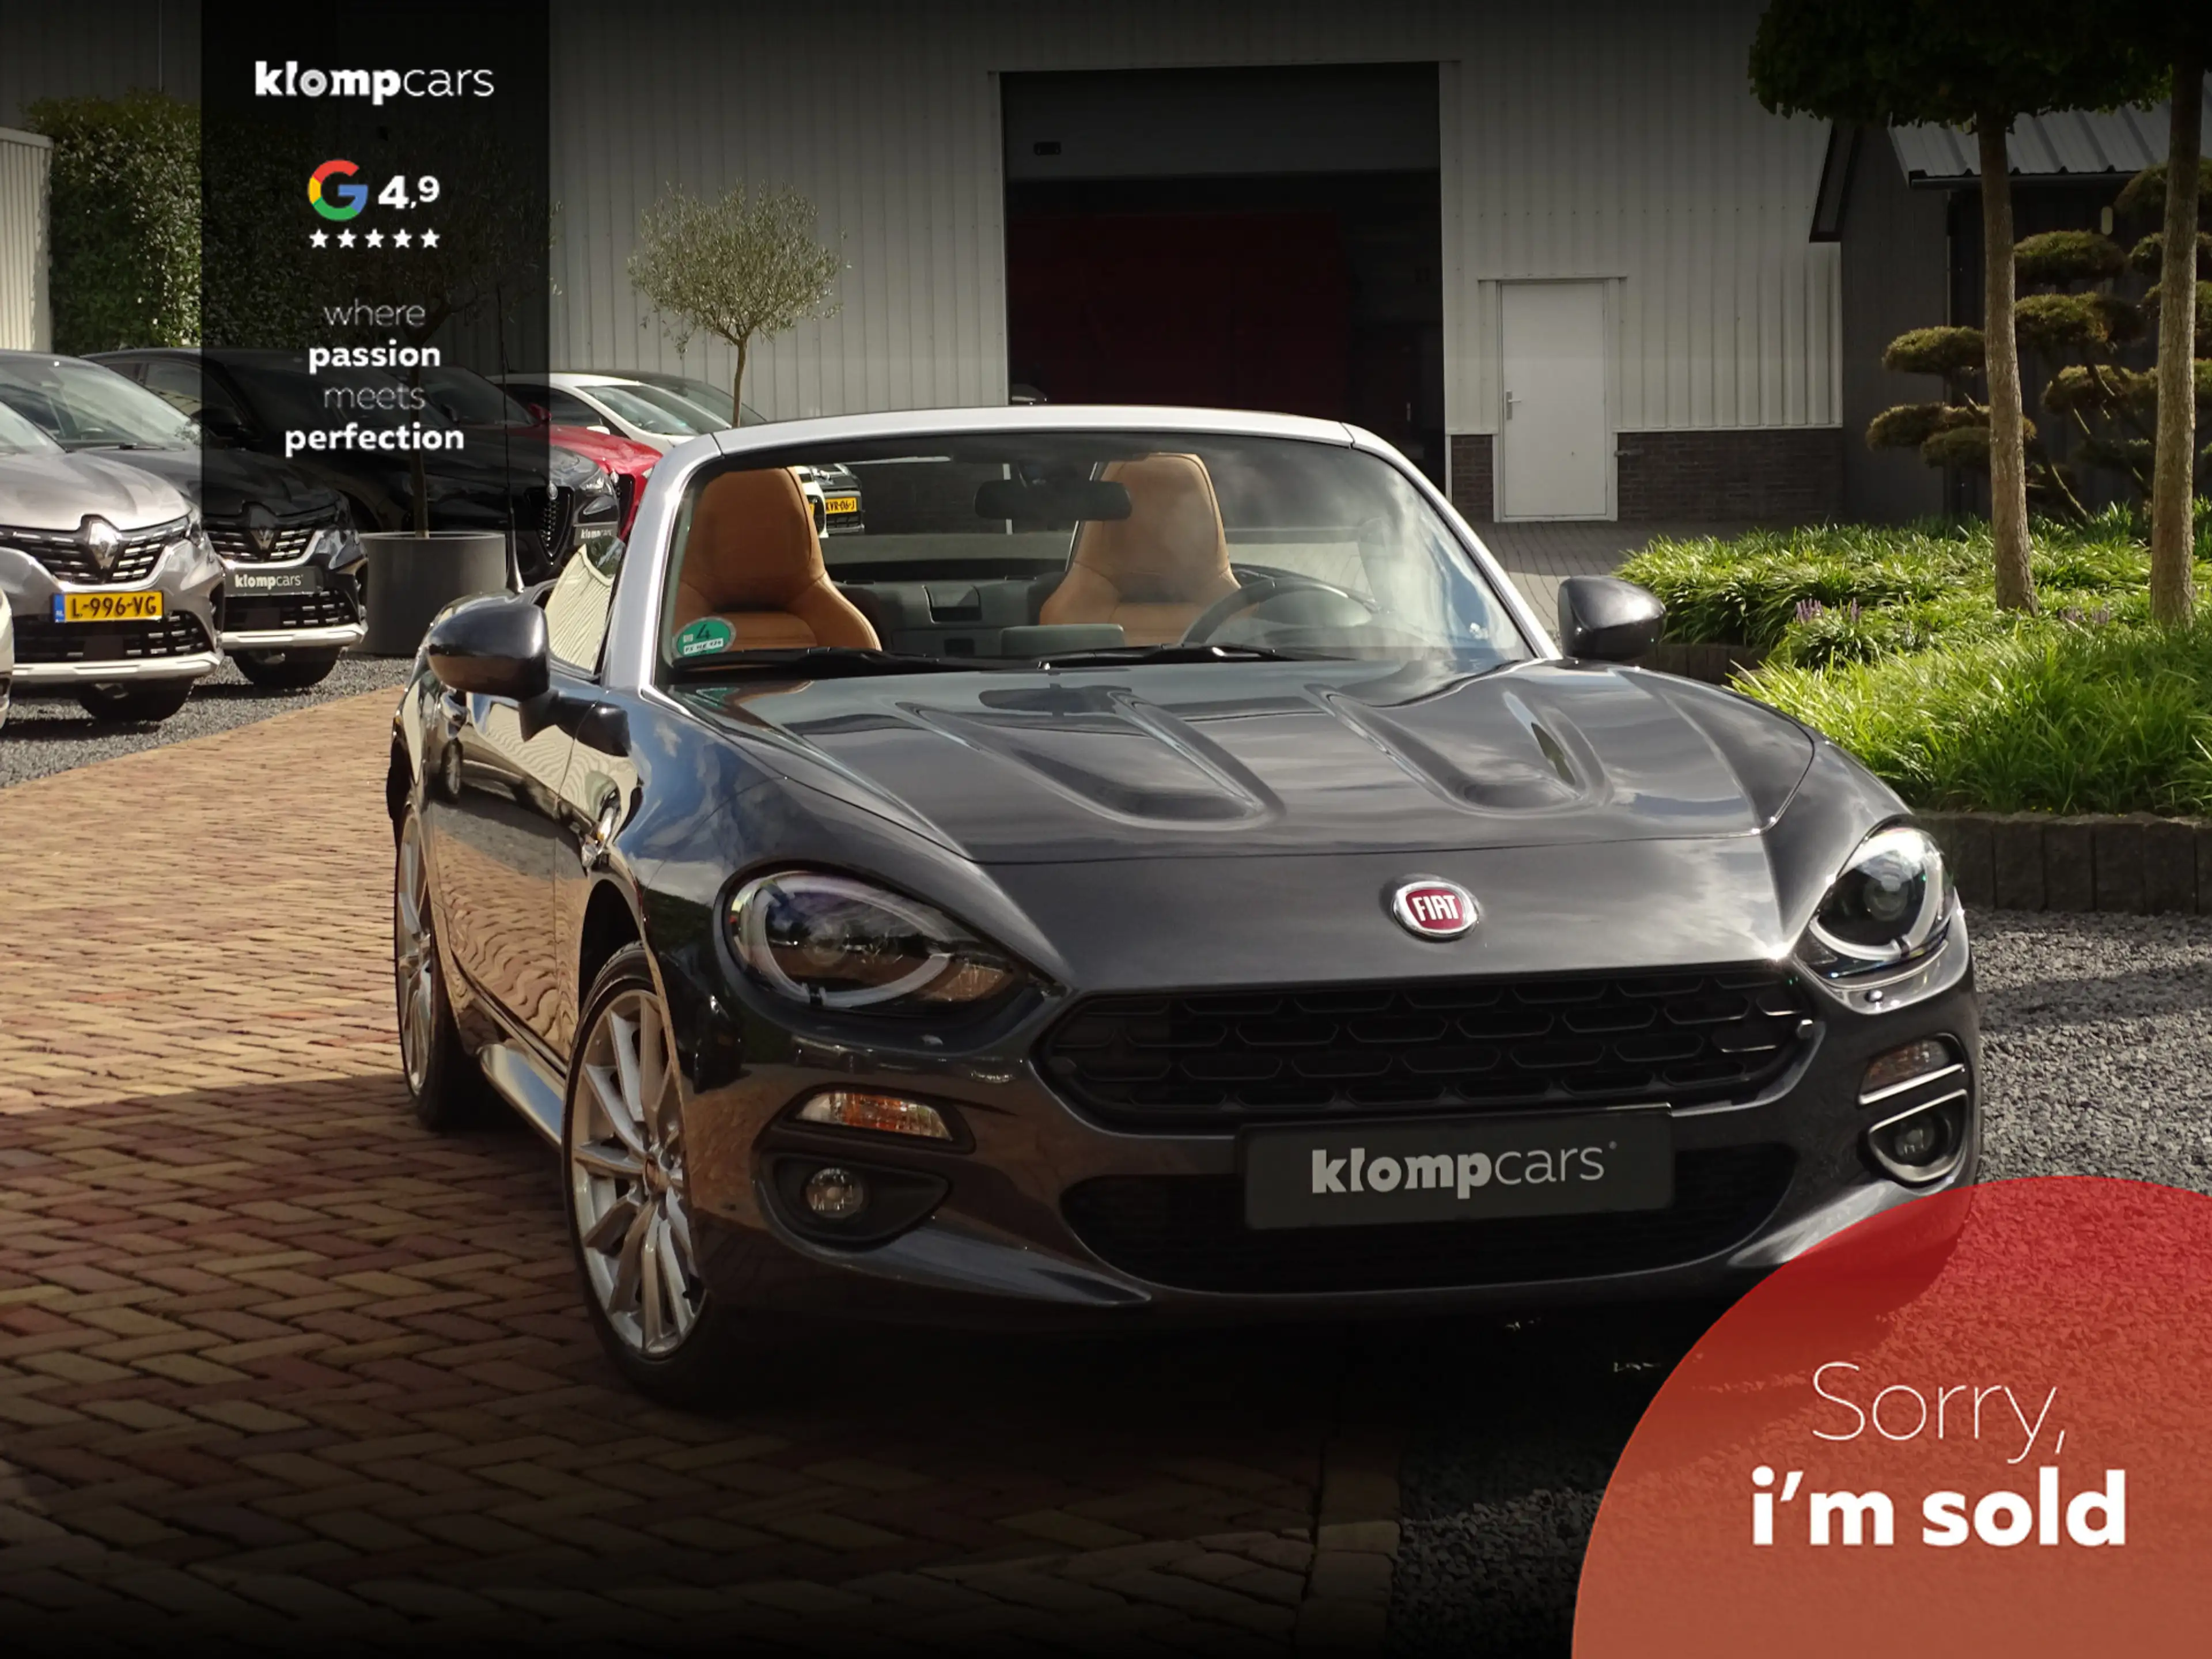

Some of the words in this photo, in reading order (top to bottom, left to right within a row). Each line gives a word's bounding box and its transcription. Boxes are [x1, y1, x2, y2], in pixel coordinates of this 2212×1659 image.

[235, 574, 302, 590] klompcars
[72, 596, 157, 618] L-996-VG
[696, 624, 711, 639] 4
[1412, 895, 1459, 922] FIAT
[1312, 1146, 1605, 1199] klompcars
